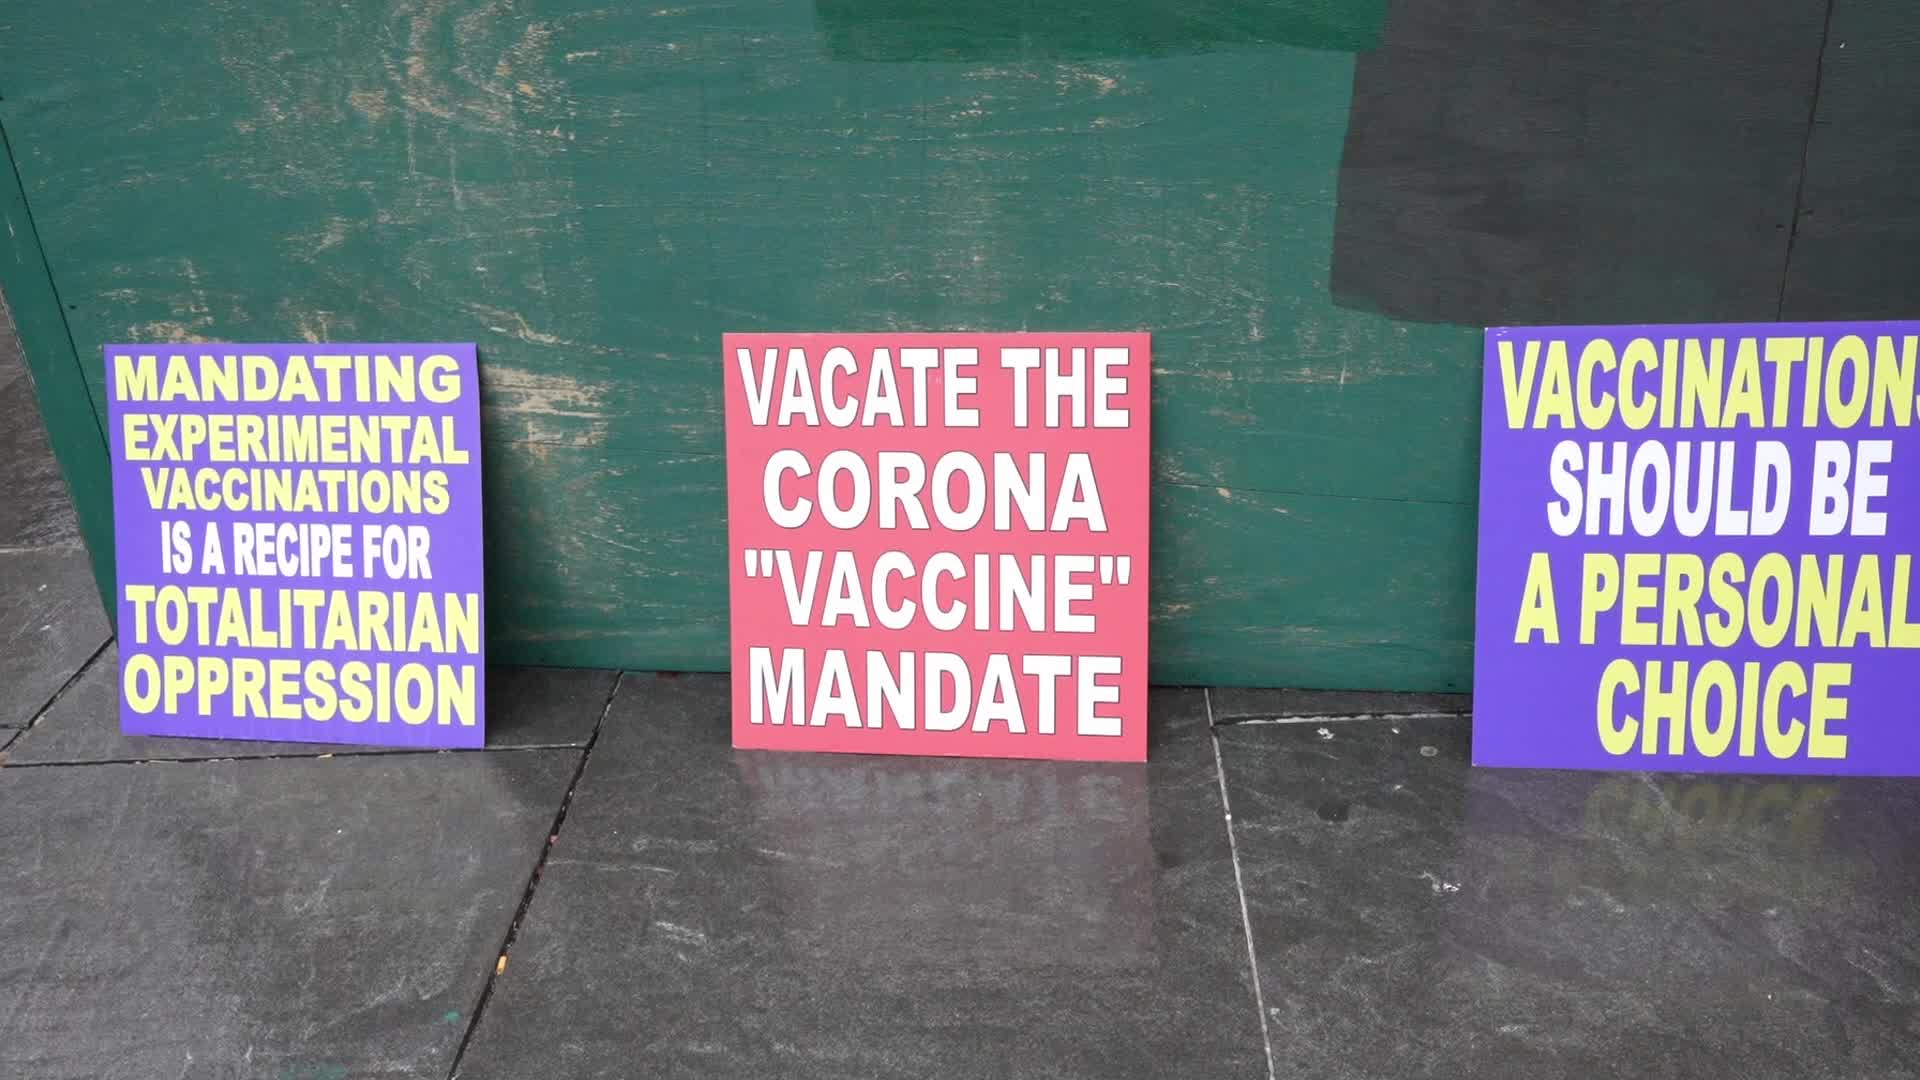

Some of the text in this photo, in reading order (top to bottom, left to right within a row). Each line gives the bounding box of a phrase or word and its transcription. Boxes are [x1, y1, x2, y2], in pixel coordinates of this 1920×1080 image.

[113, 354, 462, 404] MANDATING
[736, 346, 1129, 428] VACATE THE
[1497, 334, 1920, 431] VACCINATION
[122, 413, 470, 465] EXPERIMENTAL
[140, 466, 450, 515] VACCINATIONS
[763, 449, 1108, 532] CORONA
[1546, 439, 1893, 537] SHOULD BE
[160, 520, 433, 580] IS A RECIPE FOR
[744, 548, 1131, 633] "VACCINE"
[124, 584, 480, 655] TOTALITARIAN
[1513, 552, 1920, 649] A PERSONAL
[123, 653, 476, 727] OPPRESSION
[749, 646, 1122, 736] MANDATE
[1596, 658, 1852, 759] CHOICE
